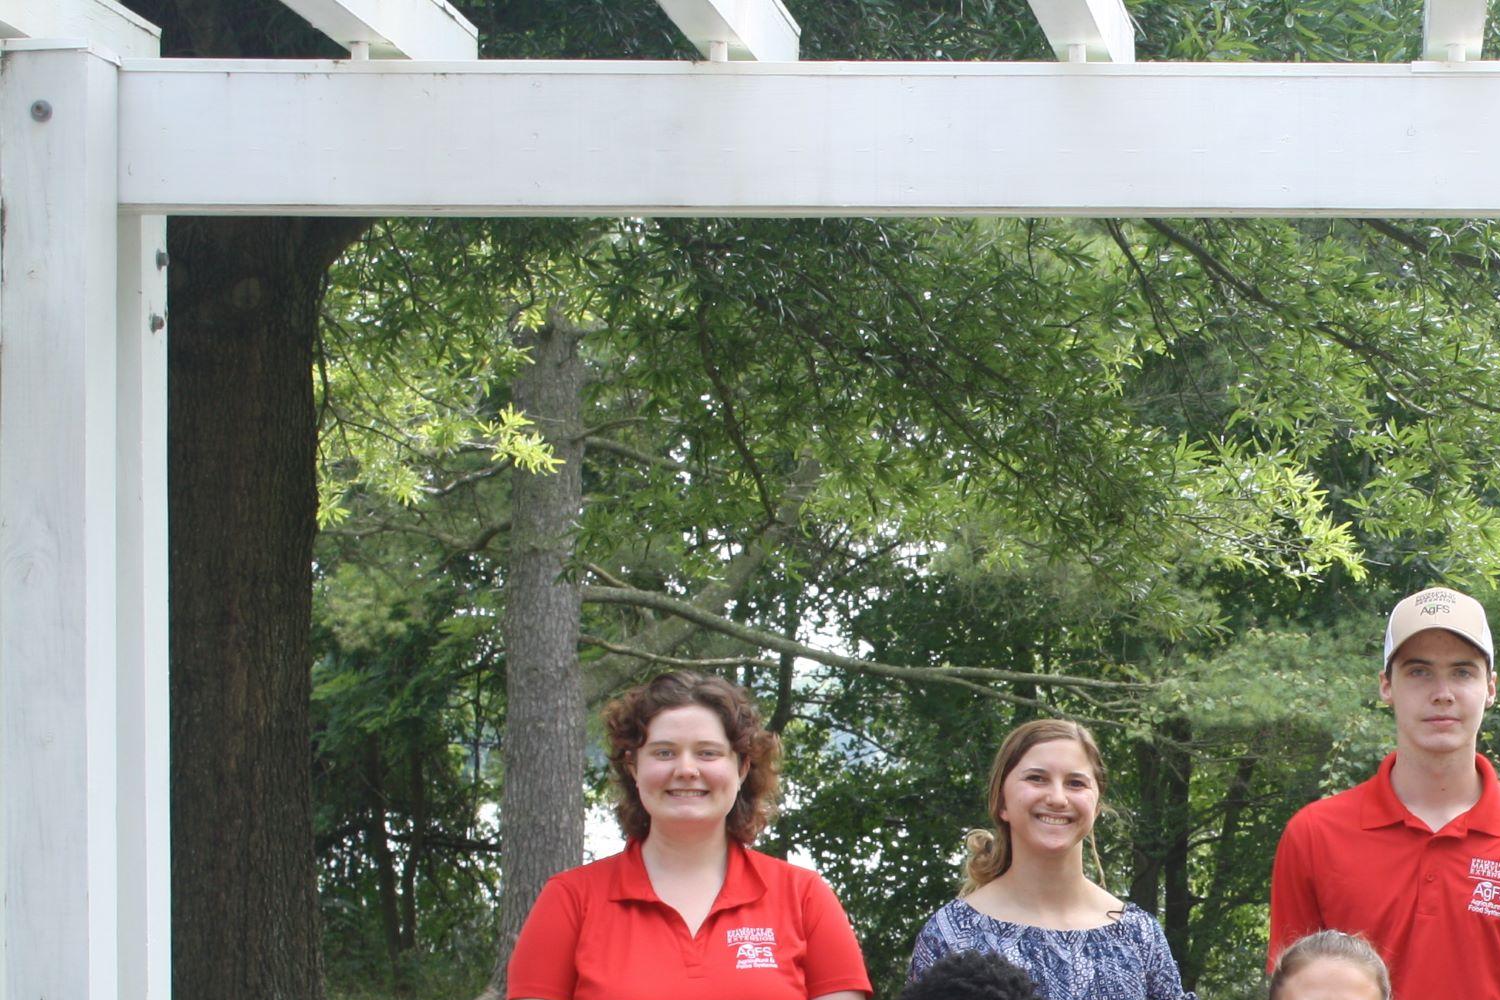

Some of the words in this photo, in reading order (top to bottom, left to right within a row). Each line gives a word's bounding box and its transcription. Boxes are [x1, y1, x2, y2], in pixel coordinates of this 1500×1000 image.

[1420, 604, 1450, 616] AgFS
[1468, 904, 1483, 913] Food
[736, 946, 772, 959] AgFS
